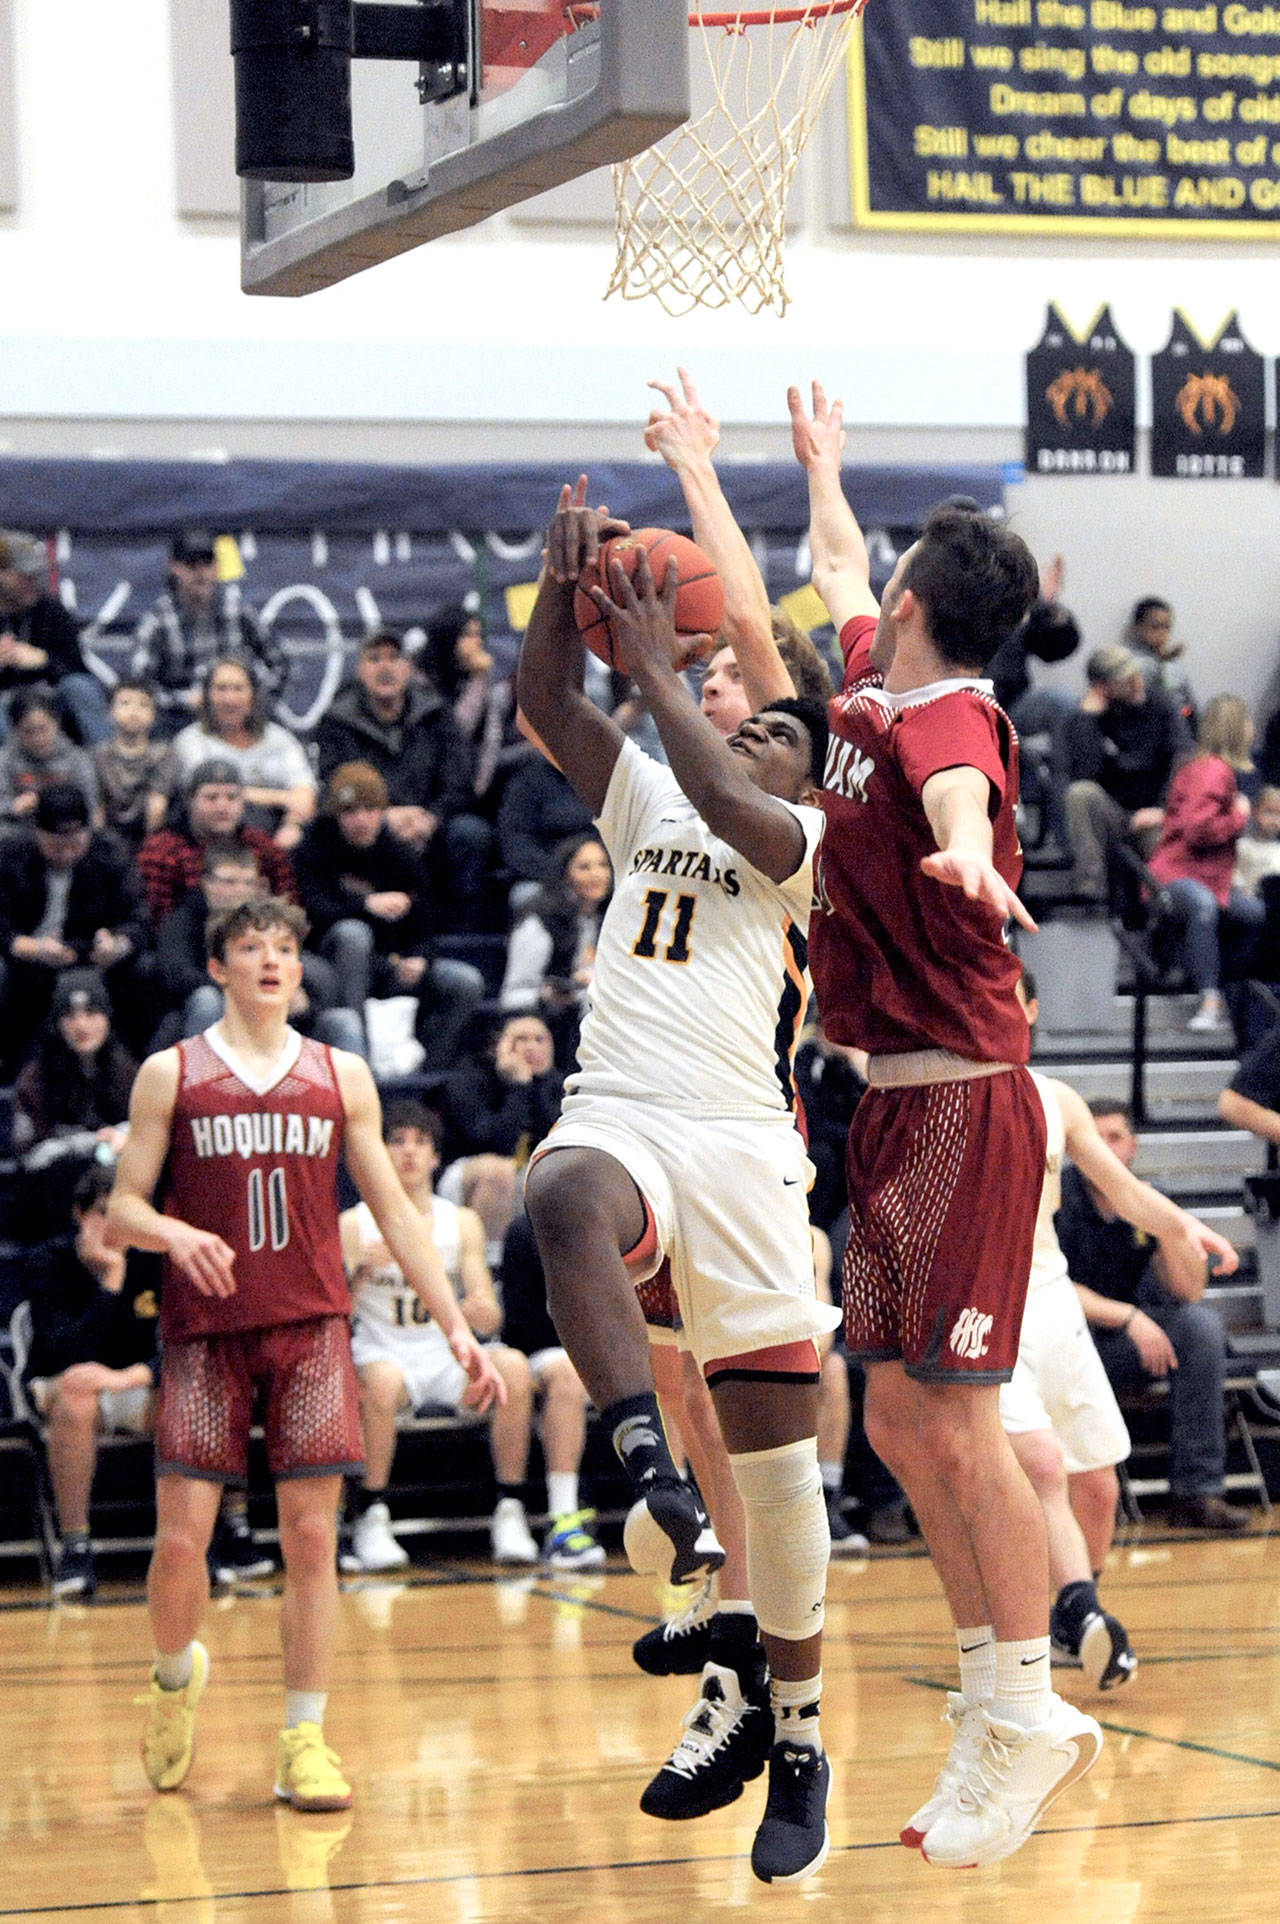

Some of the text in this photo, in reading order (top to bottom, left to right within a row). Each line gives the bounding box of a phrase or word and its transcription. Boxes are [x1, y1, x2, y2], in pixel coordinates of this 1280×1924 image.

[1037, 0, 1086, 29] the
[1090, 1, 1157, 32] Blue
[1162, 5, 1218, 33] and
[910, 36, 965, 69] Still
[971, 45, 1014, 70] we
[1020, 42, 1086, 81] sing
[1091, 45, 1139, 75] the
[1144, 46, 1192, 77] old
[989, 82, 1087, 116] Dream
[1091, 87, 1124, 117] of
[1128, 90, 1197, 128] days
[1202, 90, 1235, 123] of
[914, 124, 968, 158] Still
[973, 134, 1019, 160] we
[1025, 130, 1107, 161] cheer
[1112, 133, 1161, 163] the
[1166, 133, 1231, 166] best
[1235, 135, 1268, 166] of
[927, 170, 1003, 204] HAIL
[1011, 172, 1073, 205] THE
[1080, 174, 1168, 208] BLUE
[1174, 176, 1246, 209] AND
[630, 885, 697, 967] 11
[190, 1112, 334, 1160] HOQUIAM
[247, 1167, 290, 1252] 11
